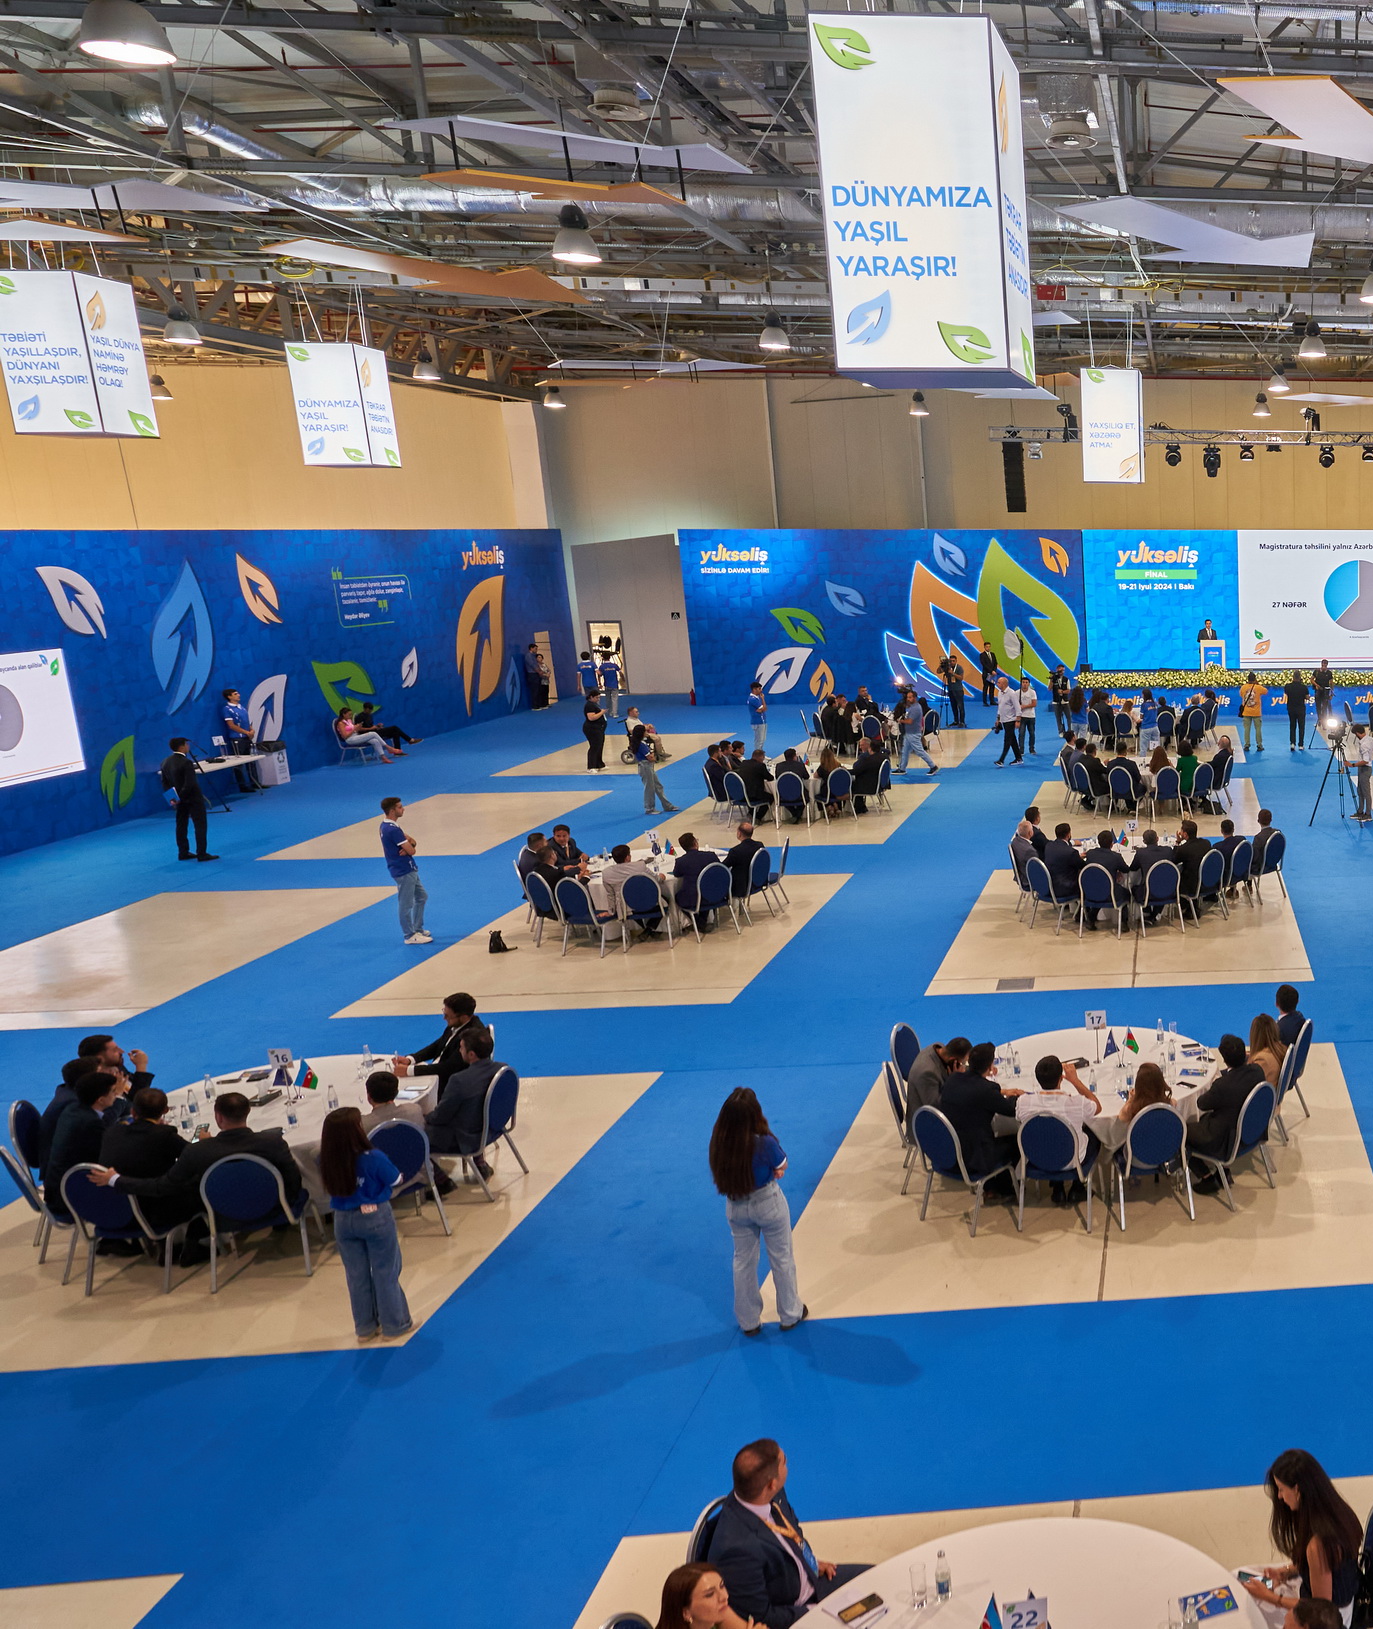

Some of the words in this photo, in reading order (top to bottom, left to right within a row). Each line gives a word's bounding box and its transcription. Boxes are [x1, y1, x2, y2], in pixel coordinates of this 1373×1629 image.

[831, 180, 993, 208] DÜNYAMIZA
[833, 220, 908, 247] YAŞIL
[836, 255, 958, 281] YARAŞIR!
[0, 331, 47, 343] TƏBİƏTİ
[90, 334, 113, 347] YAŞIL
[114, 338, 141, 352] DÜNYA
[3, 347, 82, 358] YAŞILLAŞDIR,
[93, 348, 125, 362] NAMİNƏ
[7, 360, 60, 371] DÜNYANI
[96, 362, 129, 376] HƏMRƏY
[9, 375, 89, 386] YAXŞILAŞDIR!
[98, 376, 124, 388] OLAQ!
[298, 398, 360, 408] DÜNYAMIZA
[299, 412, 329, 421] YAŞIL
[302, 424, 349, 433] YARAŞIR!
[1088, 422, 1124, 430] YAXŞILIQ
[1259, 543, 1303, 551] Magistratura
[1332, 543, 1352, 551] yalnız
[1144, 570, 1168, 578] FİNAL
[1089, 1016, 1102, 1025] 17
[274, 1054, 289, 1063] 16
[1011, 1610, 1039, 1629] 22
